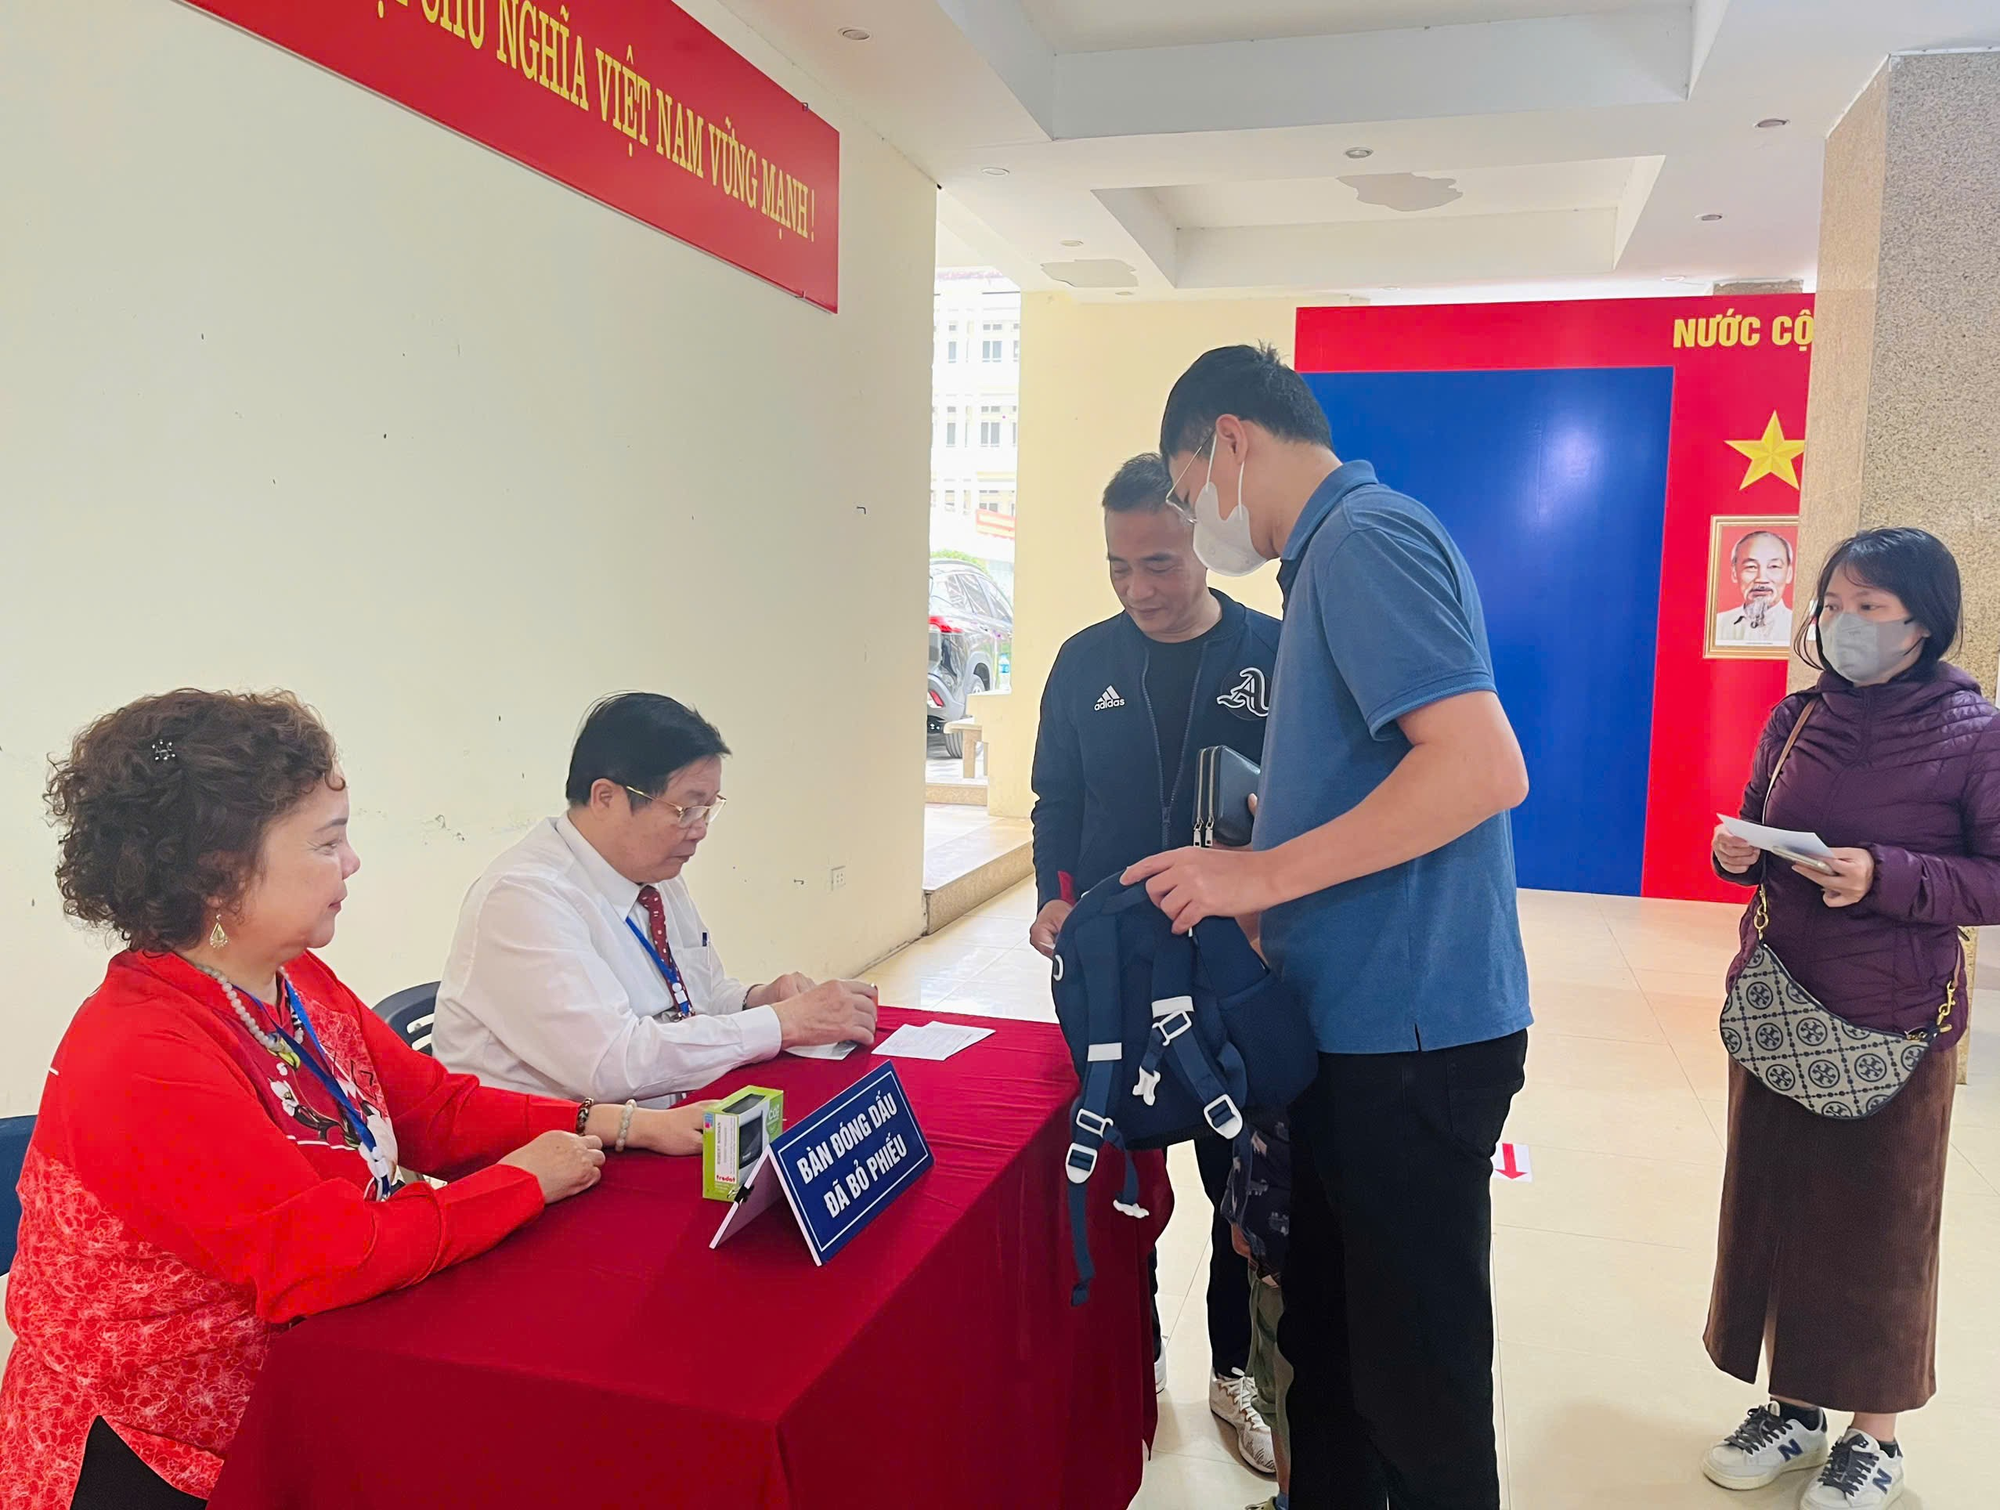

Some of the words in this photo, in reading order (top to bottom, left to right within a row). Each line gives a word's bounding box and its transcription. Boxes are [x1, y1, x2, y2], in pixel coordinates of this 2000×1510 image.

[497, 0, 589, 111] NGHĨA
[596, 45, 650, 157] VIỆT
[656, 88, 704, 178] NAM
[708, 116, 757, 209] VỮNG
[1673, 308, 1761, 348] NƯỚC
[1771, 309, 1814, 351] CỘ
[1216, 667, 1269, 717] A
[796, 1146, 834, 1184] BÀN
[829, 1121, 872, 1159] ĐÓNG
[867, 1090, 898, 1129] DẤU
[823, 1178, 850, 1218] ĐÃ
[845, 1159, 870, 1199] BỎ
[866, 1132, 907, 1182] PHIẾU
[1777, 1438, 1803, 1462] N
[1872, 1467, 1893, 1495] N
